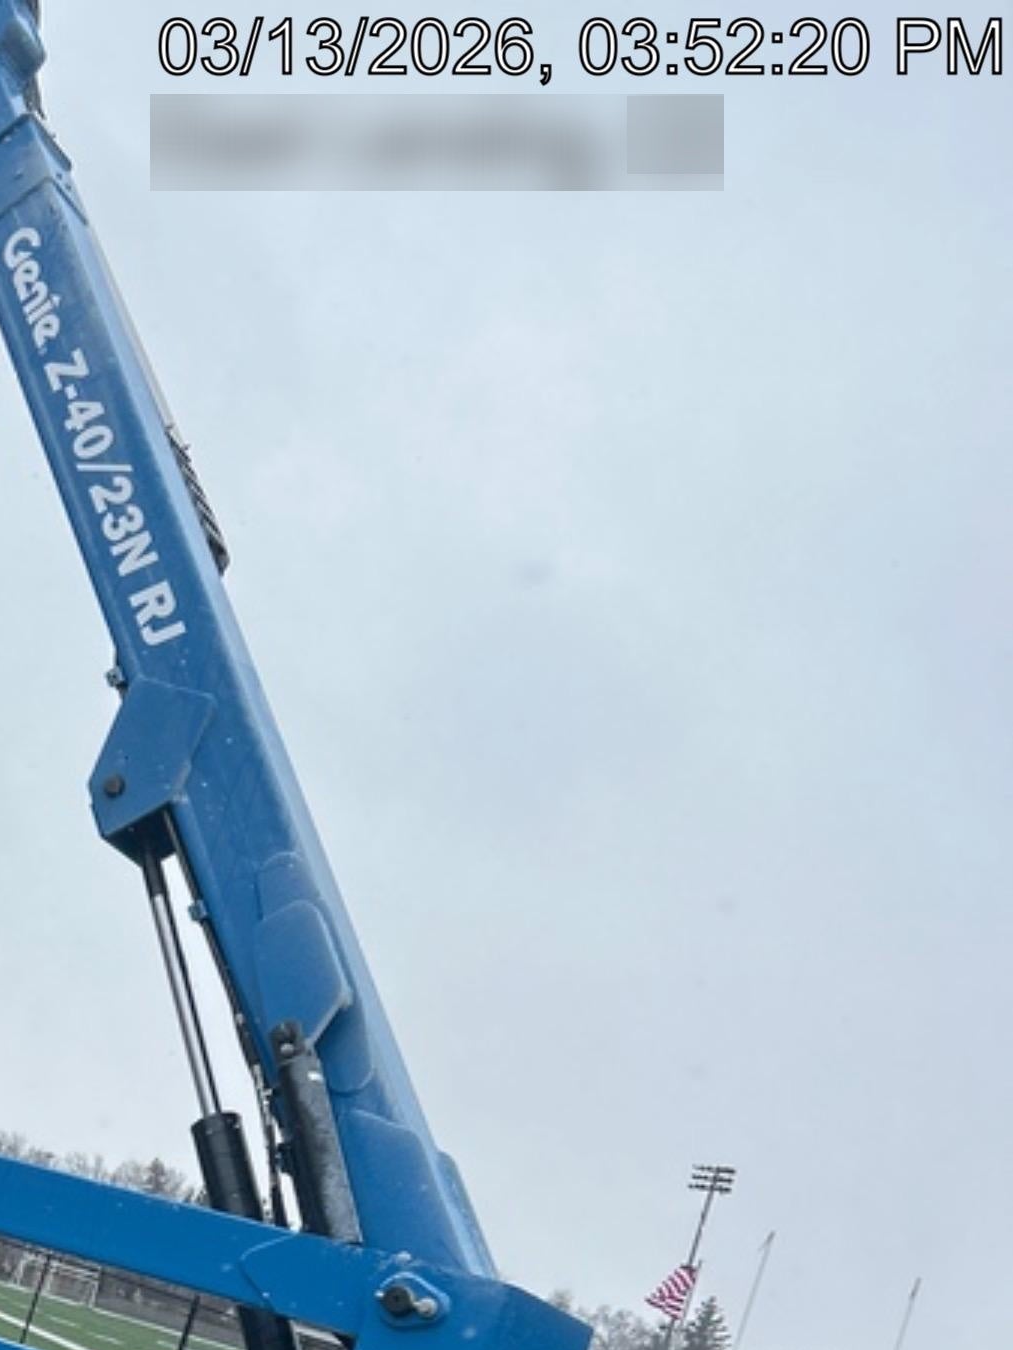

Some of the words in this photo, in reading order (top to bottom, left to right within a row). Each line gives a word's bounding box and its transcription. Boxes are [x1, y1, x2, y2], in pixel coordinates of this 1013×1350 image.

[3, 227, 61, 350] Genie
[45, 348, 160, 577] Z-40/23N
[129, 580, 187, 648] RJ
